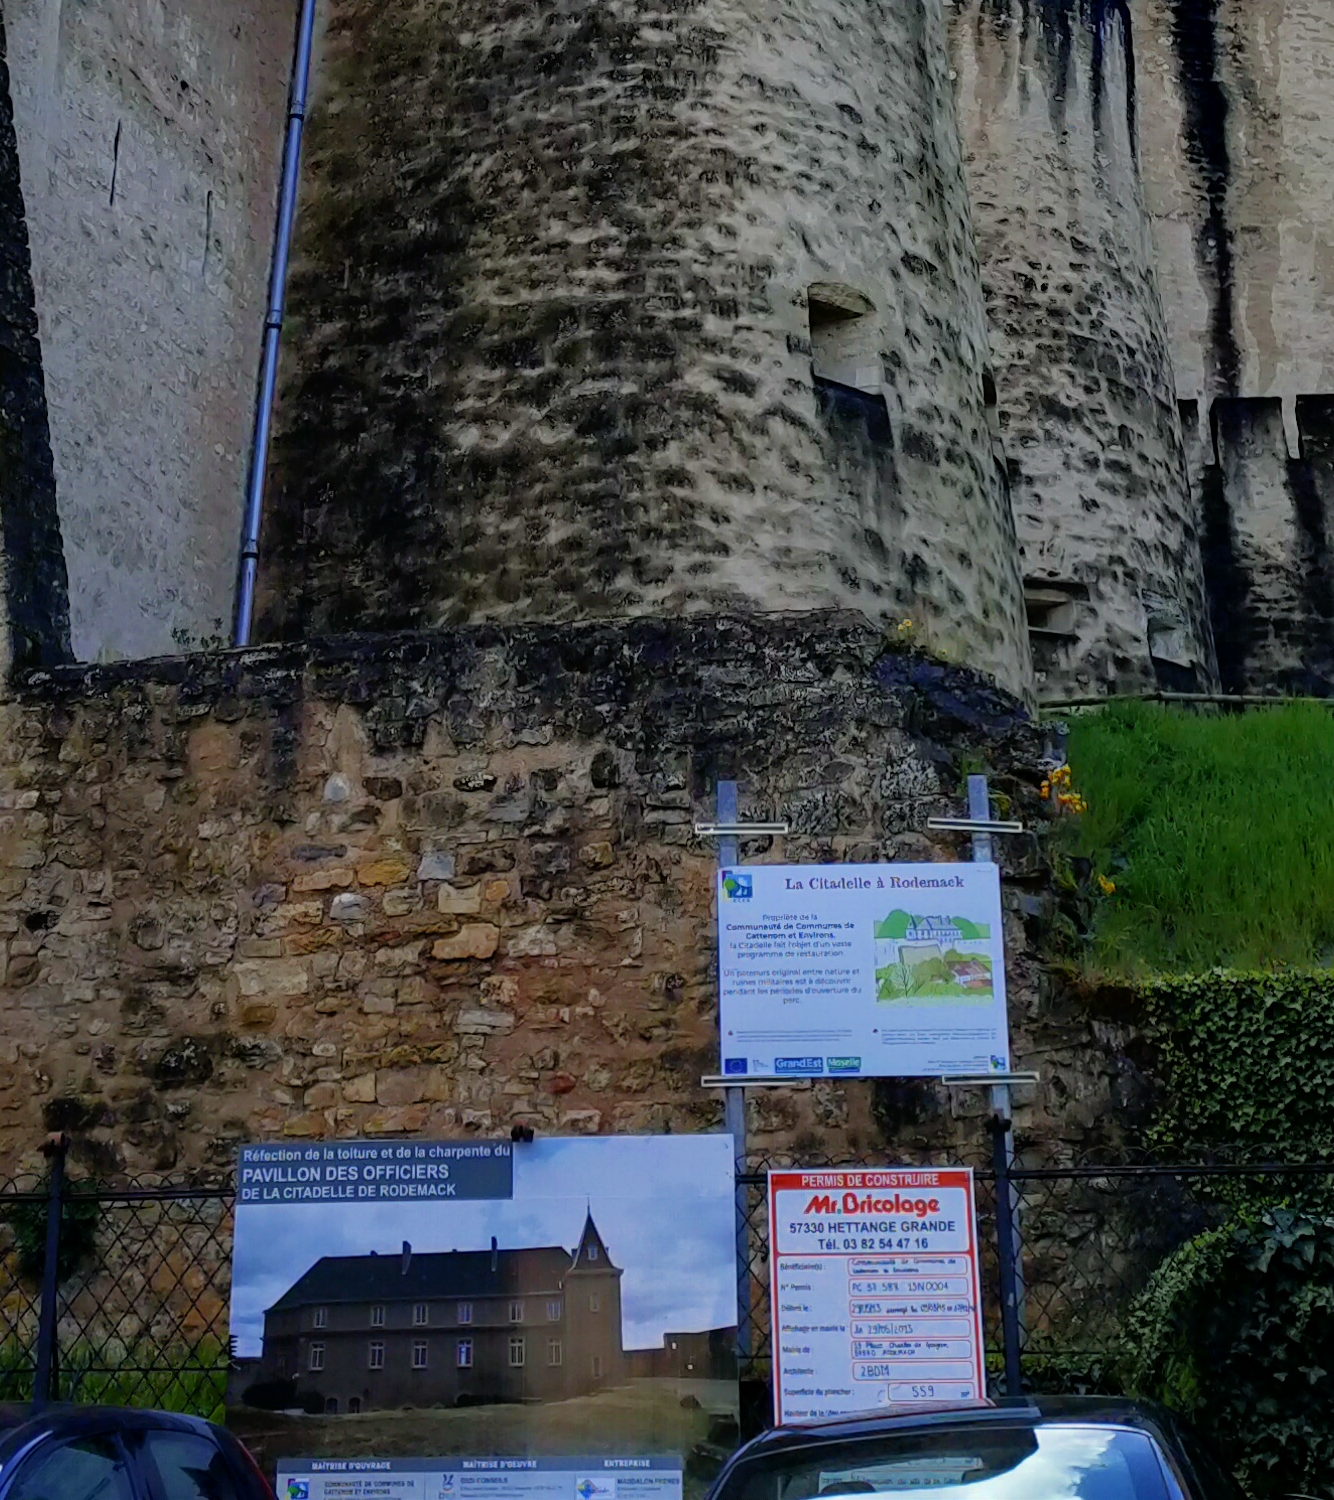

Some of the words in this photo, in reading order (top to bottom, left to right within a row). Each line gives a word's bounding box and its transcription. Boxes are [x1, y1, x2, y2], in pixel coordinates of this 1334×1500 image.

[785, 878, 803, 890] La
[809, 876, 871, 890] Citadelle
[877, 876, 885, 889] à
[890, 876, 965, 889] Rodemack
[726, 923, 781, 931] Communauté
[796, 922, 842, 930] Communes
[746, 932, 786, 940] Cattenom
[738, 941, 772, 949] Citadelle
[737, 951, 784, 960] programme
[736, 970, 770, 978] parcours
[772, 969, 801, 977] original
[758, 978, 793, 986] militaires
[815, 977, 852, 985] découvrir
[723, 988, 756, 996] pendant
[770, 987, 803, 996] périodes
[804, 986, 850, 995] d'ouverture
[828, 1058, 860, 1067] Moselle
[244, 1150, 301, 1162] Réfection
[305, 1149, 318, 1160] de
[323, 1148, 334, 1160] la
[337, 1148, 378, 1160] toiture
[381, 1148, 393, 1159] et
[396, 1147, 411, 1159] de
[415, 1146, 426, 1158] la
[429, 1146, 491, 1160] charpente
[495, 1145, 510, 1156] du
[243, 1167, 320, 1183] PAVILLON
[326, 1166, 358, 1181] DES
[363, 1164, 449, 1180] OFFICIERS
[801, 1175, 844, 1187] PERMIS
[847, 1175, 862, 1186] DE
[866, 1173, 940, 1185] CONSTRUIRE
[242, 1188, 259, 1200] DE
[263, 1187, 279, 1199] LA
[283, 1186, 354, 1198] CITADELLE
[358, 1185, 376, 1197] DE
[380, 1184, 456, 1196] RODEMACK
[789, 1222, 824, 1233] 57330
[828, 1221, 896, 1233] HETTANGE
[901, 1221, 956, 1232] GRANDE
[818, 1239, 840, 1250] Tél.
[843, 1239, 857, 1250] 03
[861, 1239, 875, 1250] 82
[879, 1238, 893, 1249] 54
[897, 1238, 910, 1249] 47
[914, 1238, 928, 1249] 16
[852, 1283, 862, 1292] PC
[912, 1386, 934, 1398] 559
[312, 1461, 346, 1470] MAÎTRISE
[348, 1461, 391, 1470] D'OUVRAGE
[604, 1459, 651, 1468] ENTREPRISE
